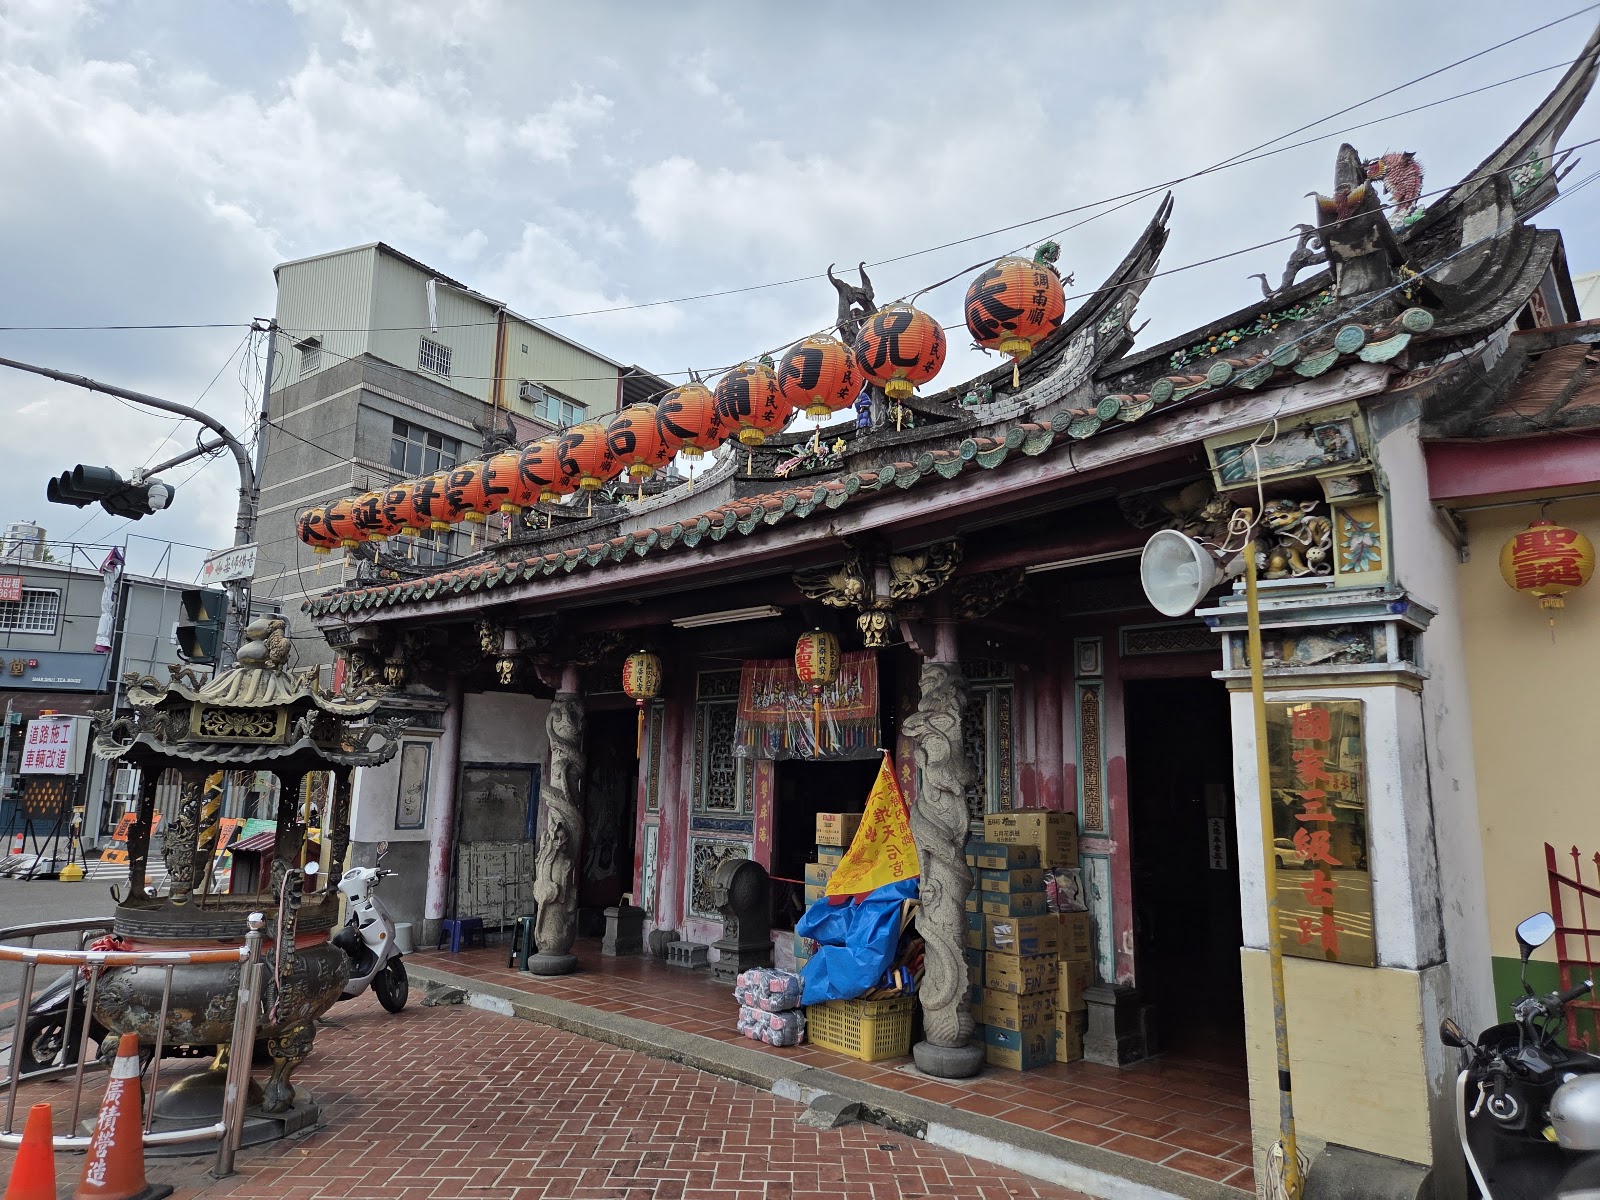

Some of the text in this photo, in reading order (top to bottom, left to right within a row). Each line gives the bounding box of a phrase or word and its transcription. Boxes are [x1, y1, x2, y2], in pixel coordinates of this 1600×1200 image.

[1512, 528, 1584, 590] 聖誕
[818, 637, 827, 675] 國泰民安
[25, 749, 66, 768] 車輛改道
[29, 724, 70, 744] 道路施工
[1292, 707, 1344, 956] 國家三級古蹟
[86, 1080, 124, 1186] 廣積營造
